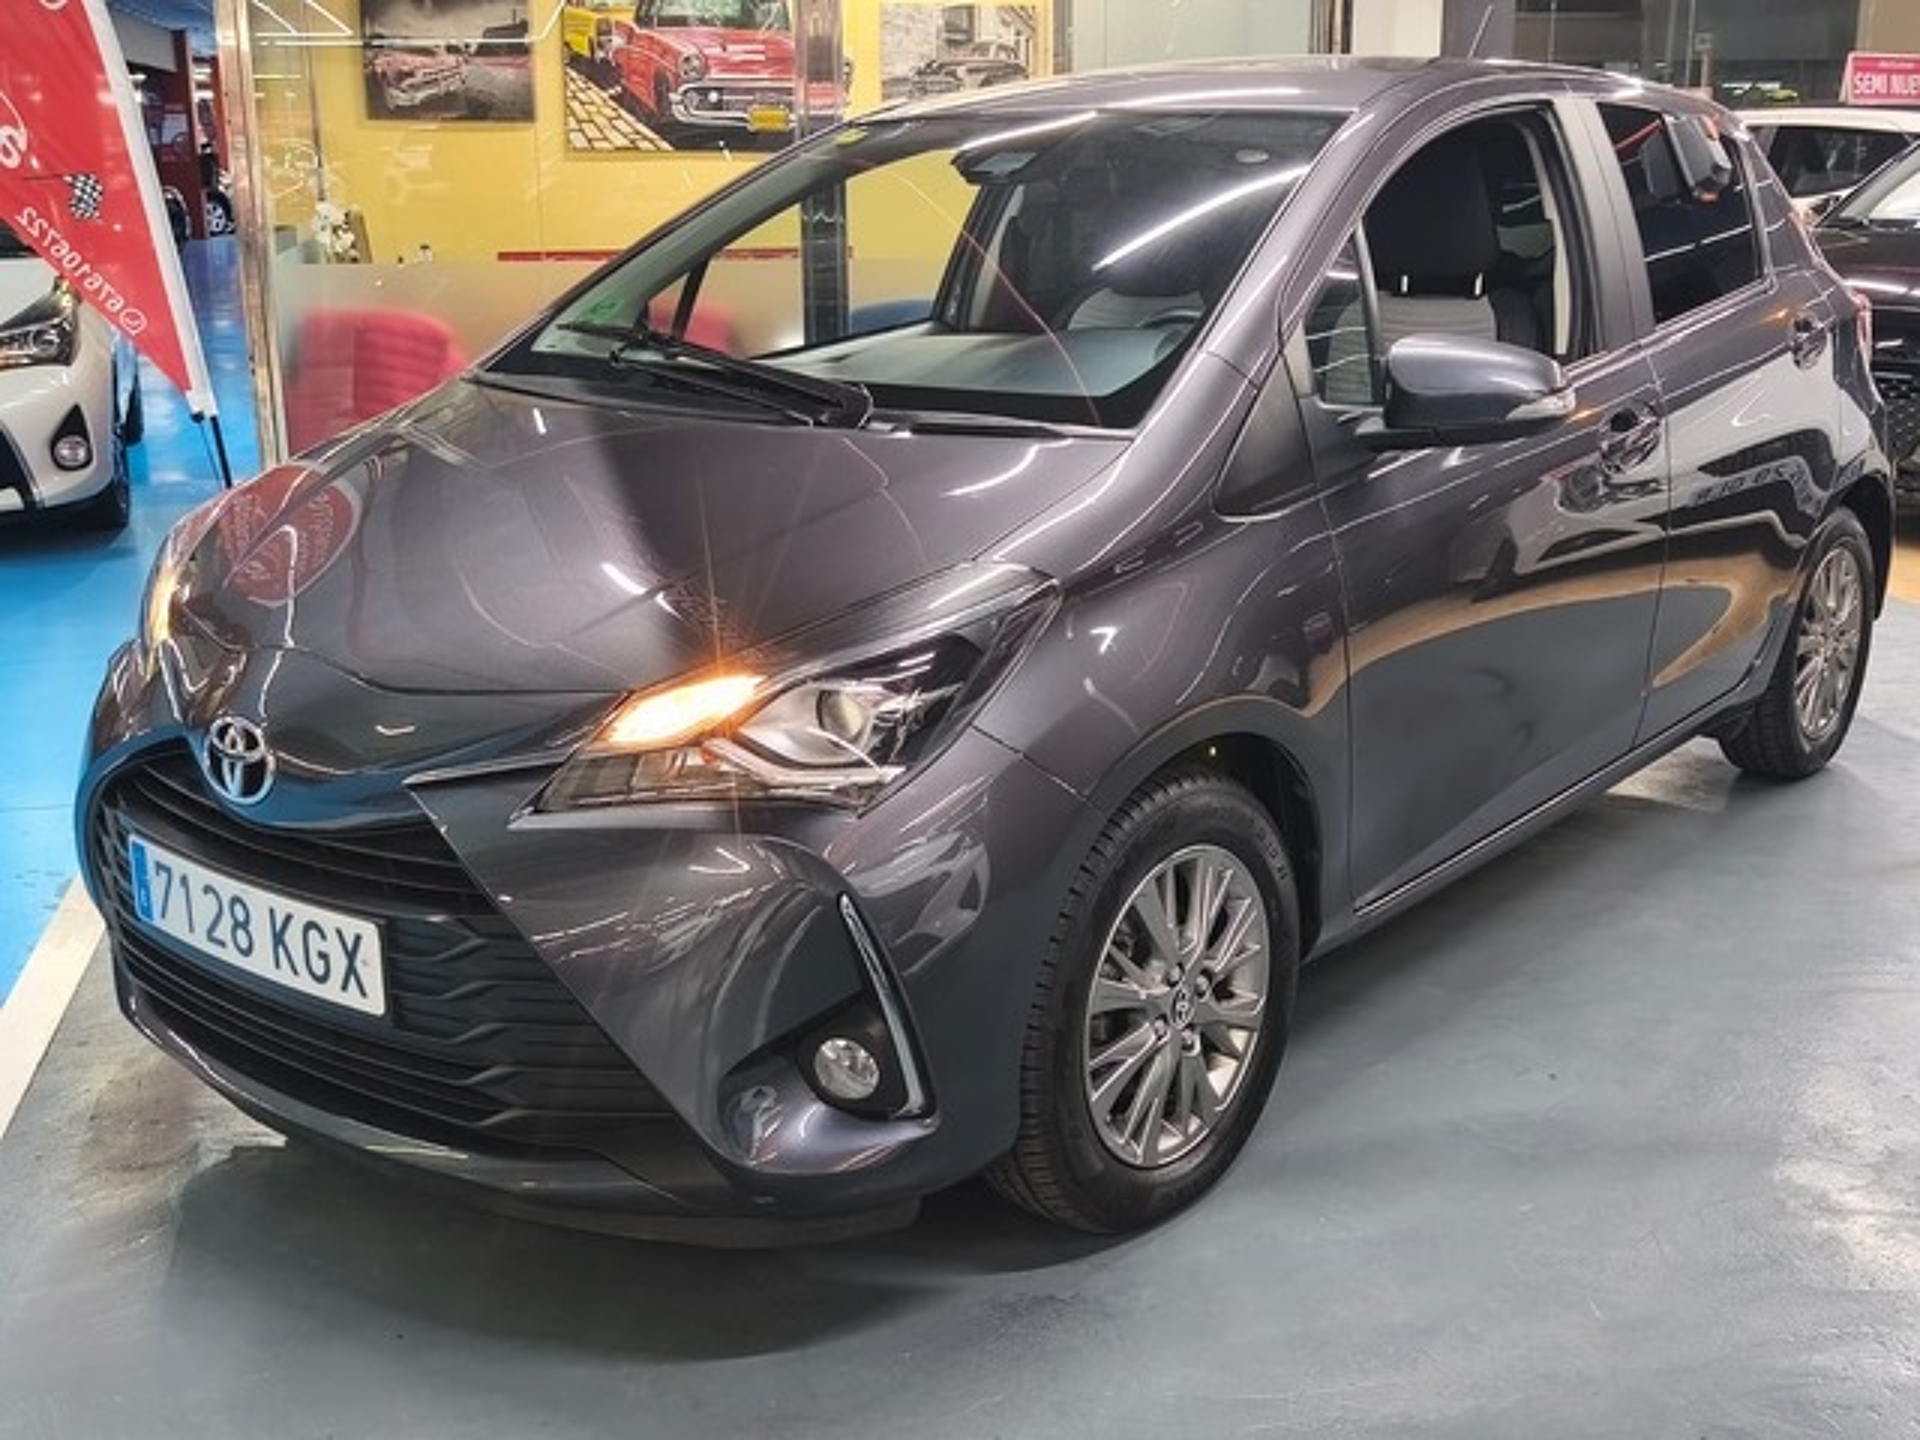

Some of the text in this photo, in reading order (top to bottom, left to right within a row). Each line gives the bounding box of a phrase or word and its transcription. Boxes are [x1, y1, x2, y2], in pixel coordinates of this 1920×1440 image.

[1853, 71, 1888, 95] SEMI
[155, 861, 368, 999] 7128 KGX
